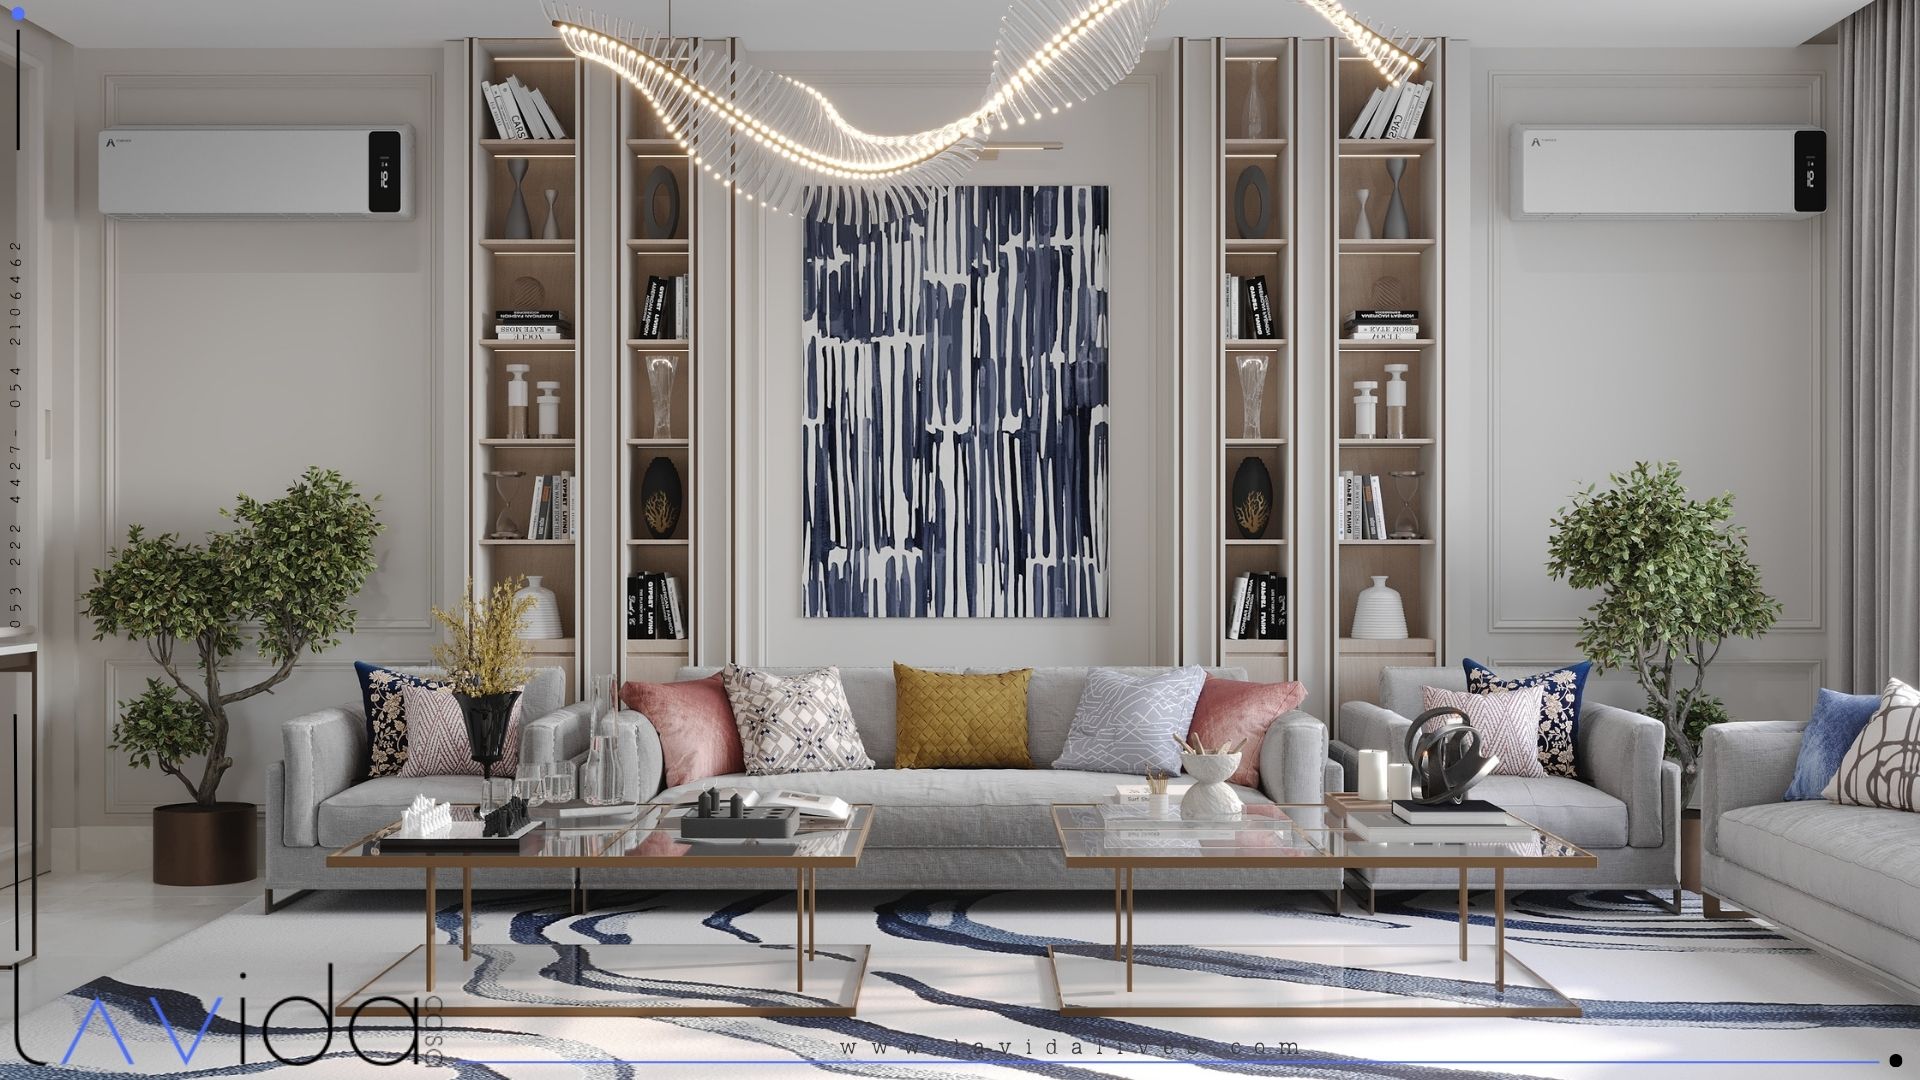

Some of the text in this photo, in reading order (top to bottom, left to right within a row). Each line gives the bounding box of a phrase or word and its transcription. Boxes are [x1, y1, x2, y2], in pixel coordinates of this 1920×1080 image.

[511, 115, 526, 139] CARS
[643, 281, 657, 337] AMERICAN FASHION
[651, 285, 665, 335] GYPSET LIVING
[660, 579, 670, 609] AMERICAN
[665, 609, 674, 635] FASHION
